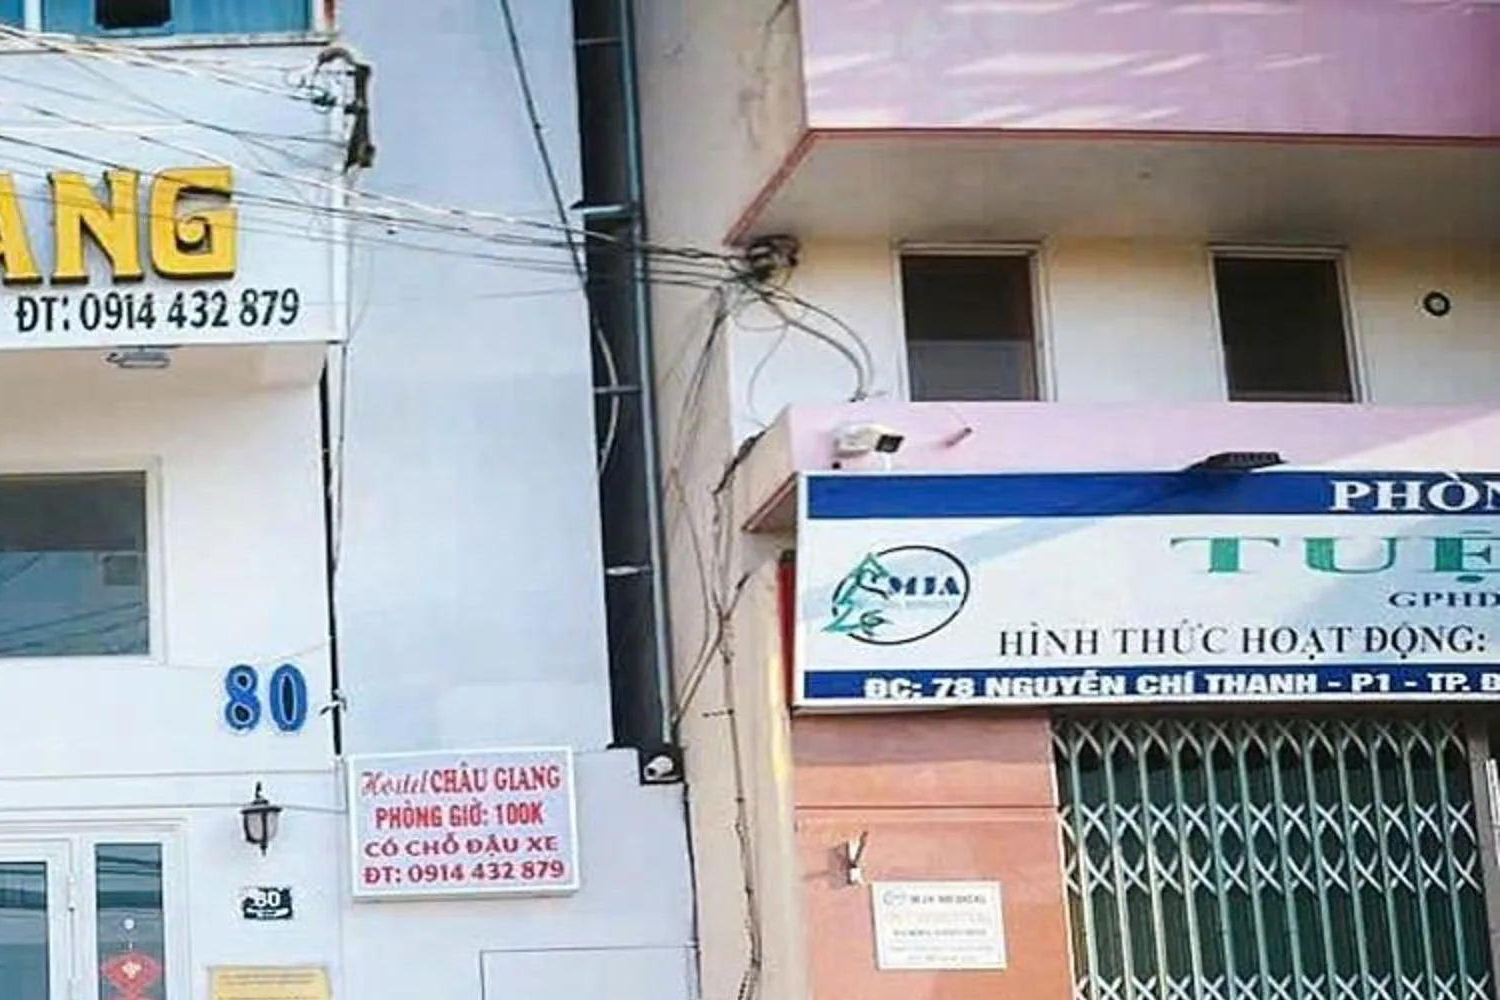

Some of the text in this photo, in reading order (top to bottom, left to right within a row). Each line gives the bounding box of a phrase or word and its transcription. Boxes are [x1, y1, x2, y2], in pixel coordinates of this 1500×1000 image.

[15, 287, 300, 333] ĐT: 0914 432 879
[1000, 618, 1486, 661] HÌNH THỨC HOẠT ĐỘNG:
[224, 663, 308, 732] 80
[931, 677, 975, 698] 78
[985, 670, 1126, 697] NGUYỄN
[1136, 670, 1195, 695] CHÍ
[1204, 673, 1317, 694] THANH
[1351, 673, 1391, 693] P1
[1427, 672, 1471, 692] TP.
[361, 762, 561, 796] Hostel CHÂU GIANG
[375, 800, 443, 829] PHÒNG
[496, 802, 544, 825] 100K
[364, 837, 399, 857] CÓ
[405, 833, 460, 857] CHỖ
[527, 836, 559, 852] XE
[364, 859, 565, 884] ĐT: 0914 432 879
